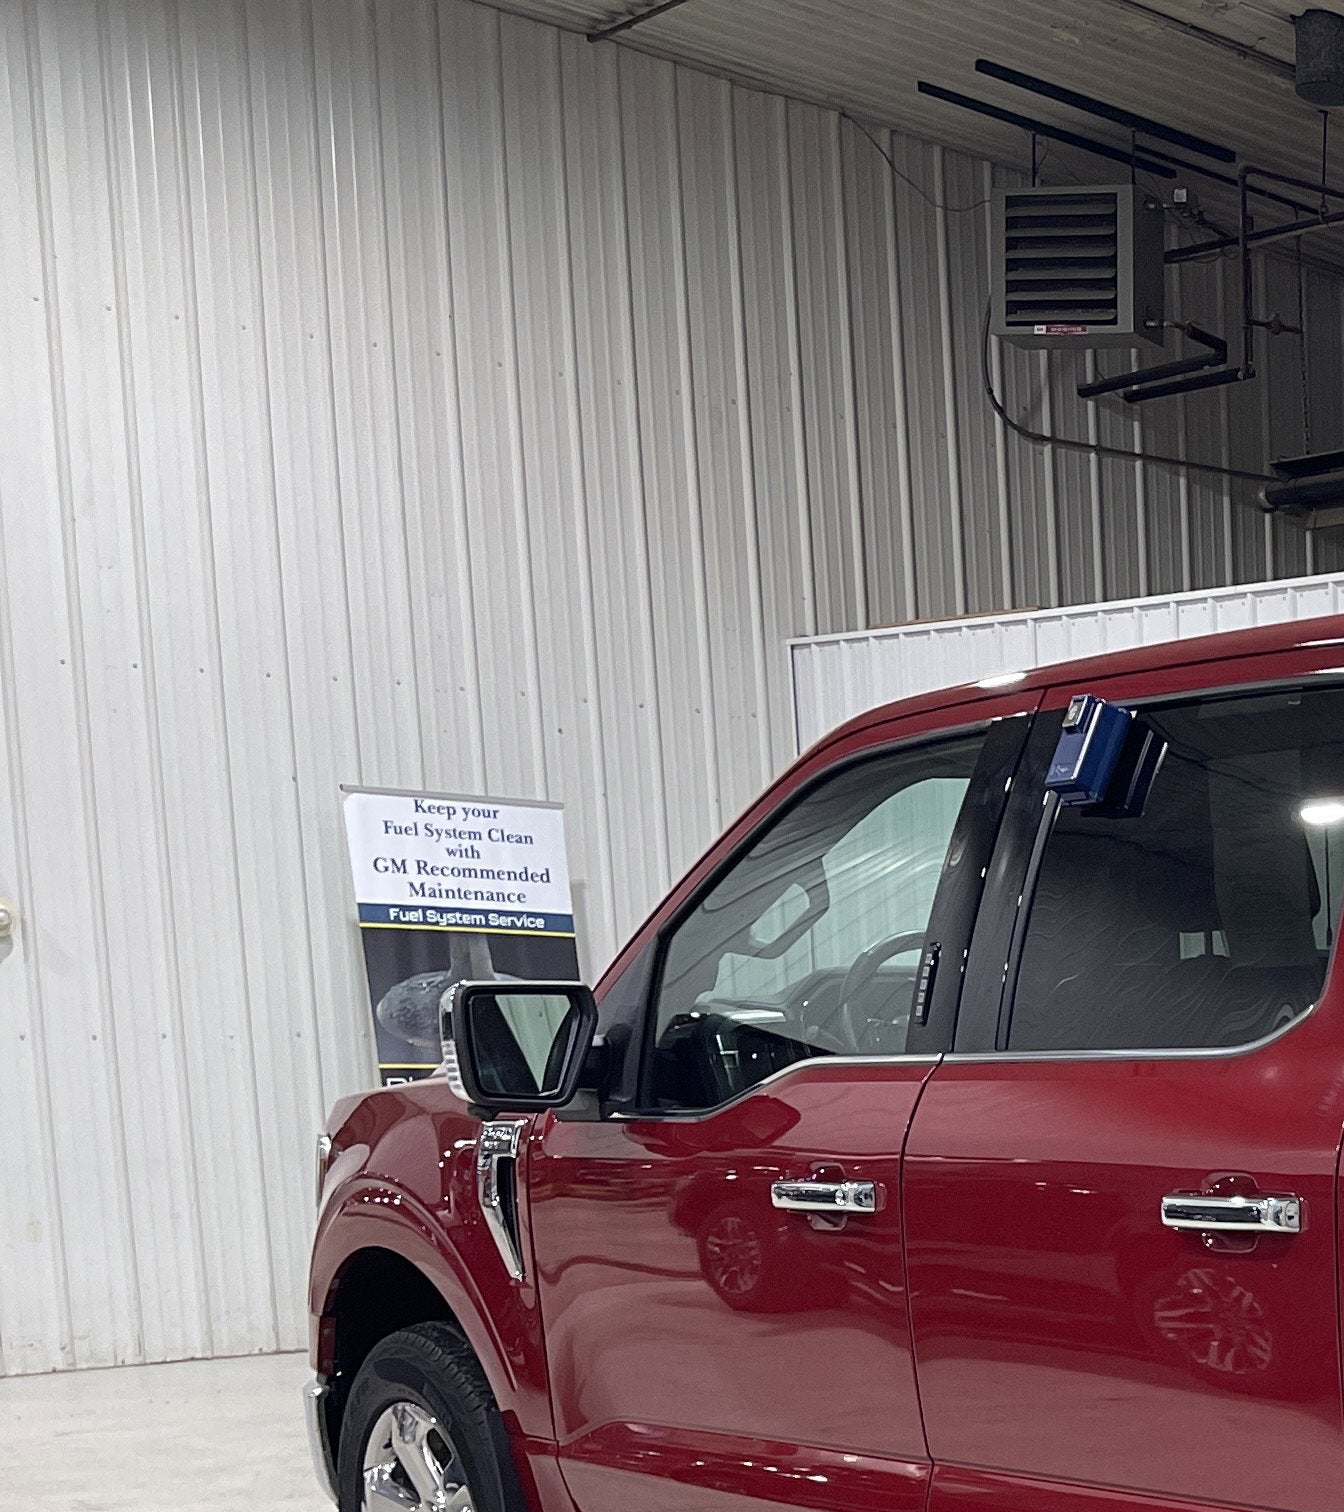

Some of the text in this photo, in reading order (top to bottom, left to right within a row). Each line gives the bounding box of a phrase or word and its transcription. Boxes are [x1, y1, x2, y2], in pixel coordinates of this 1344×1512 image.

[414, 799, 499, 821] Keep your
[383, 820, 533, 845] Fuel System Clean
[446, 844, 481, 859] with
[373, 857, 551, 883] GM Recommended
[408, 882, 526, 903] Maintenance
[389, 908, 545, 928] Fuel System Service
